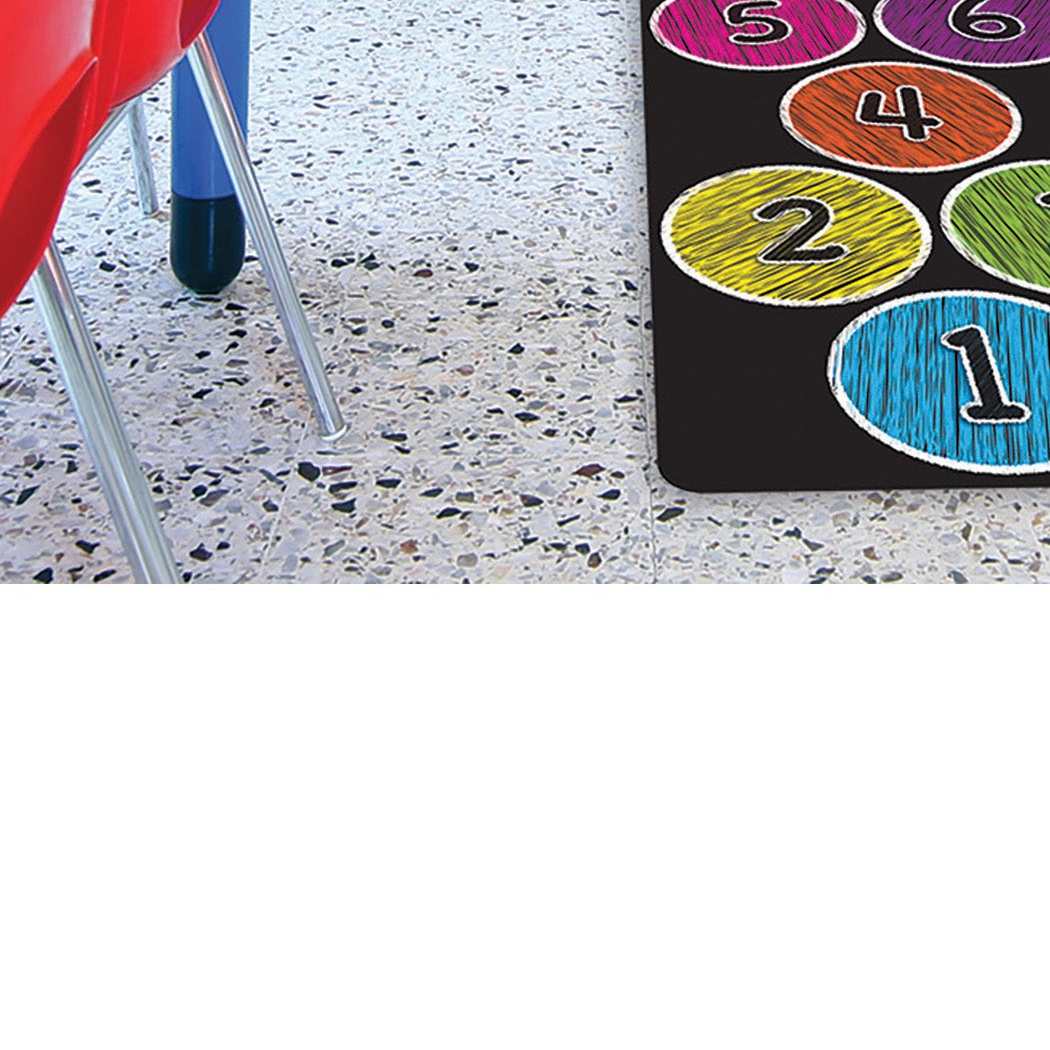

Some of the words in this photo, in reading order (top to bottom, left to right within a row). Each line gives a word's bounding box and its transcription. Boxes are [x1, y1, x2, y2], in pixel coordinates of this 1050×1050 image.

[724, 0, 793, 44] 5
[856, 85, 942, 141] 4
[752, 197, 850, 263] 2
[940, 324, 1032, 424] 1
